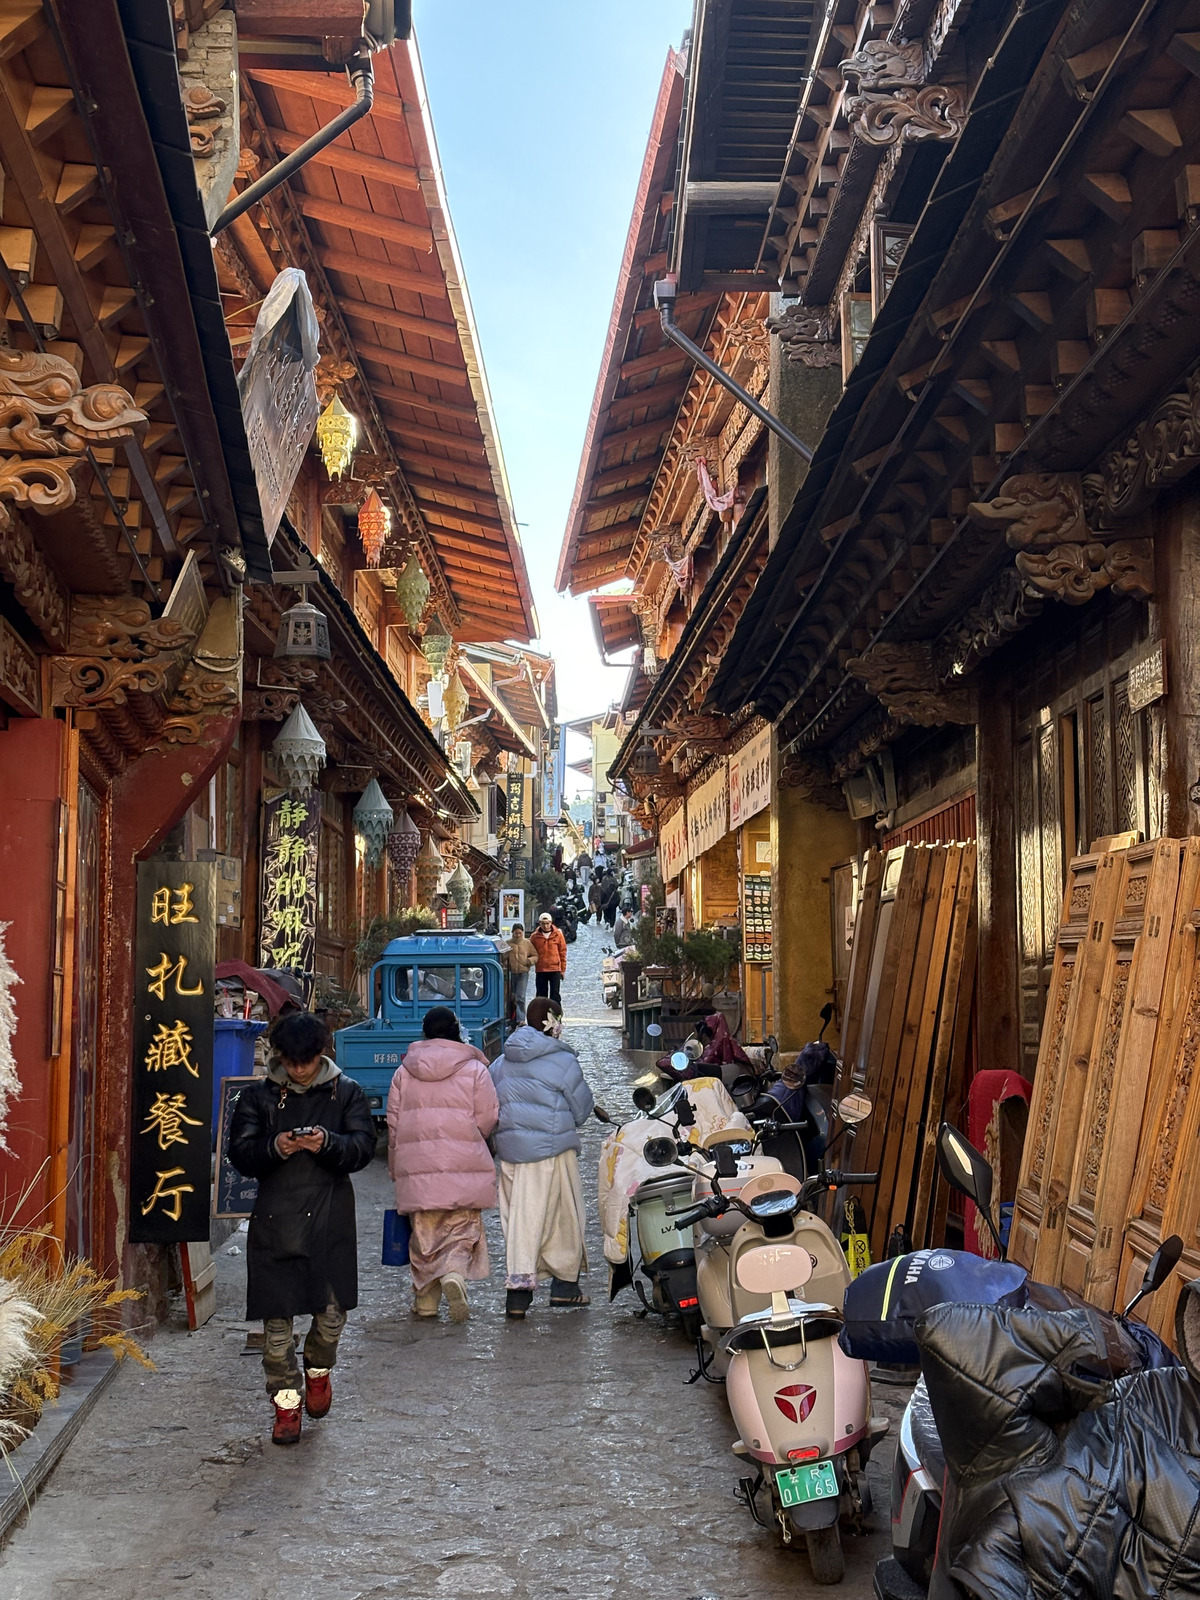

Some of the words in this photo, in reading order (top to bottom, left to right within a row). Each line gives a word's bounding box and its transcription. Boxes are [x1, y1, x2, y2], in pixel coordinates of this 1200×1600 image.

[508, 782, 521, 839] 玛吉阿妈
[140, 882, 204, 1222] 旺扎藏餐厅
[783, 1478, 834, 1503] 01165
[810, 1468, 821, 1480] R
